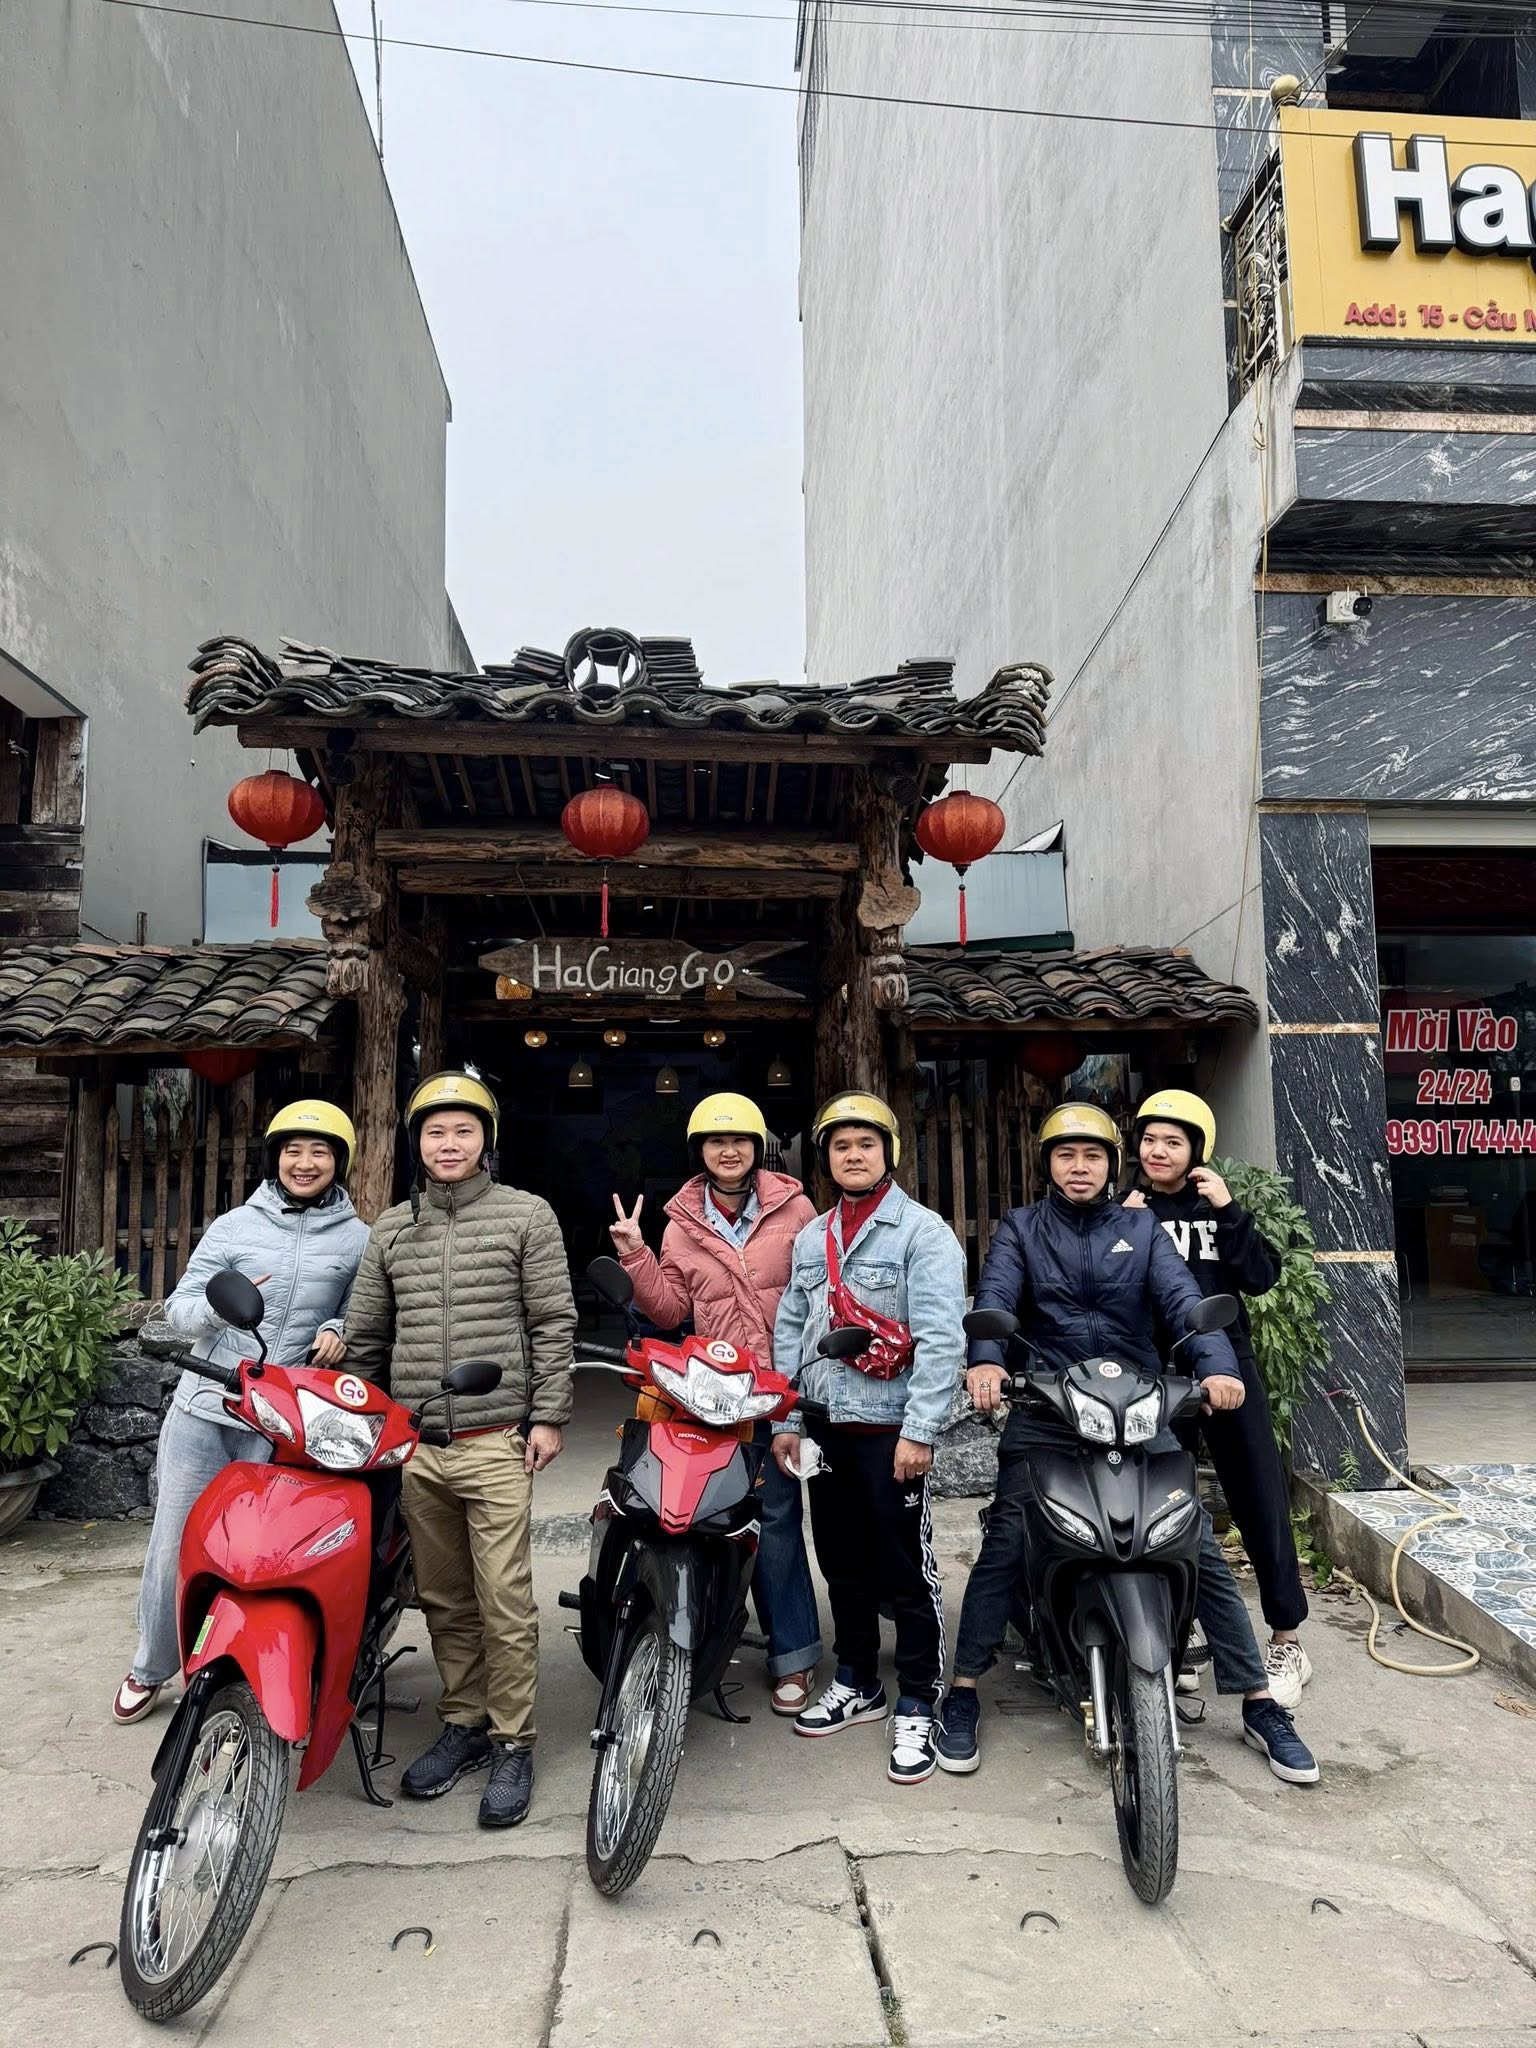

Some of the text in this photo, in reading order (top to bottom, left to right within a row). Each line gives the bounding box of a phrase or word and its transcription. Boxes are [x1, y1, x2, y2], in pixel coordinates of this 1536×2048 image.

[1353, 131, 1536, 275] Ha
[1344, 302, 1406, 327] Add:
[532, 943, 734, 994] HaGiangGo
[1385, 1008, 1518, 1052] Mời Vào
[1416, 1068, 1492, 1105] 24/24
[677, 1432, 708, 1444] HONDA
